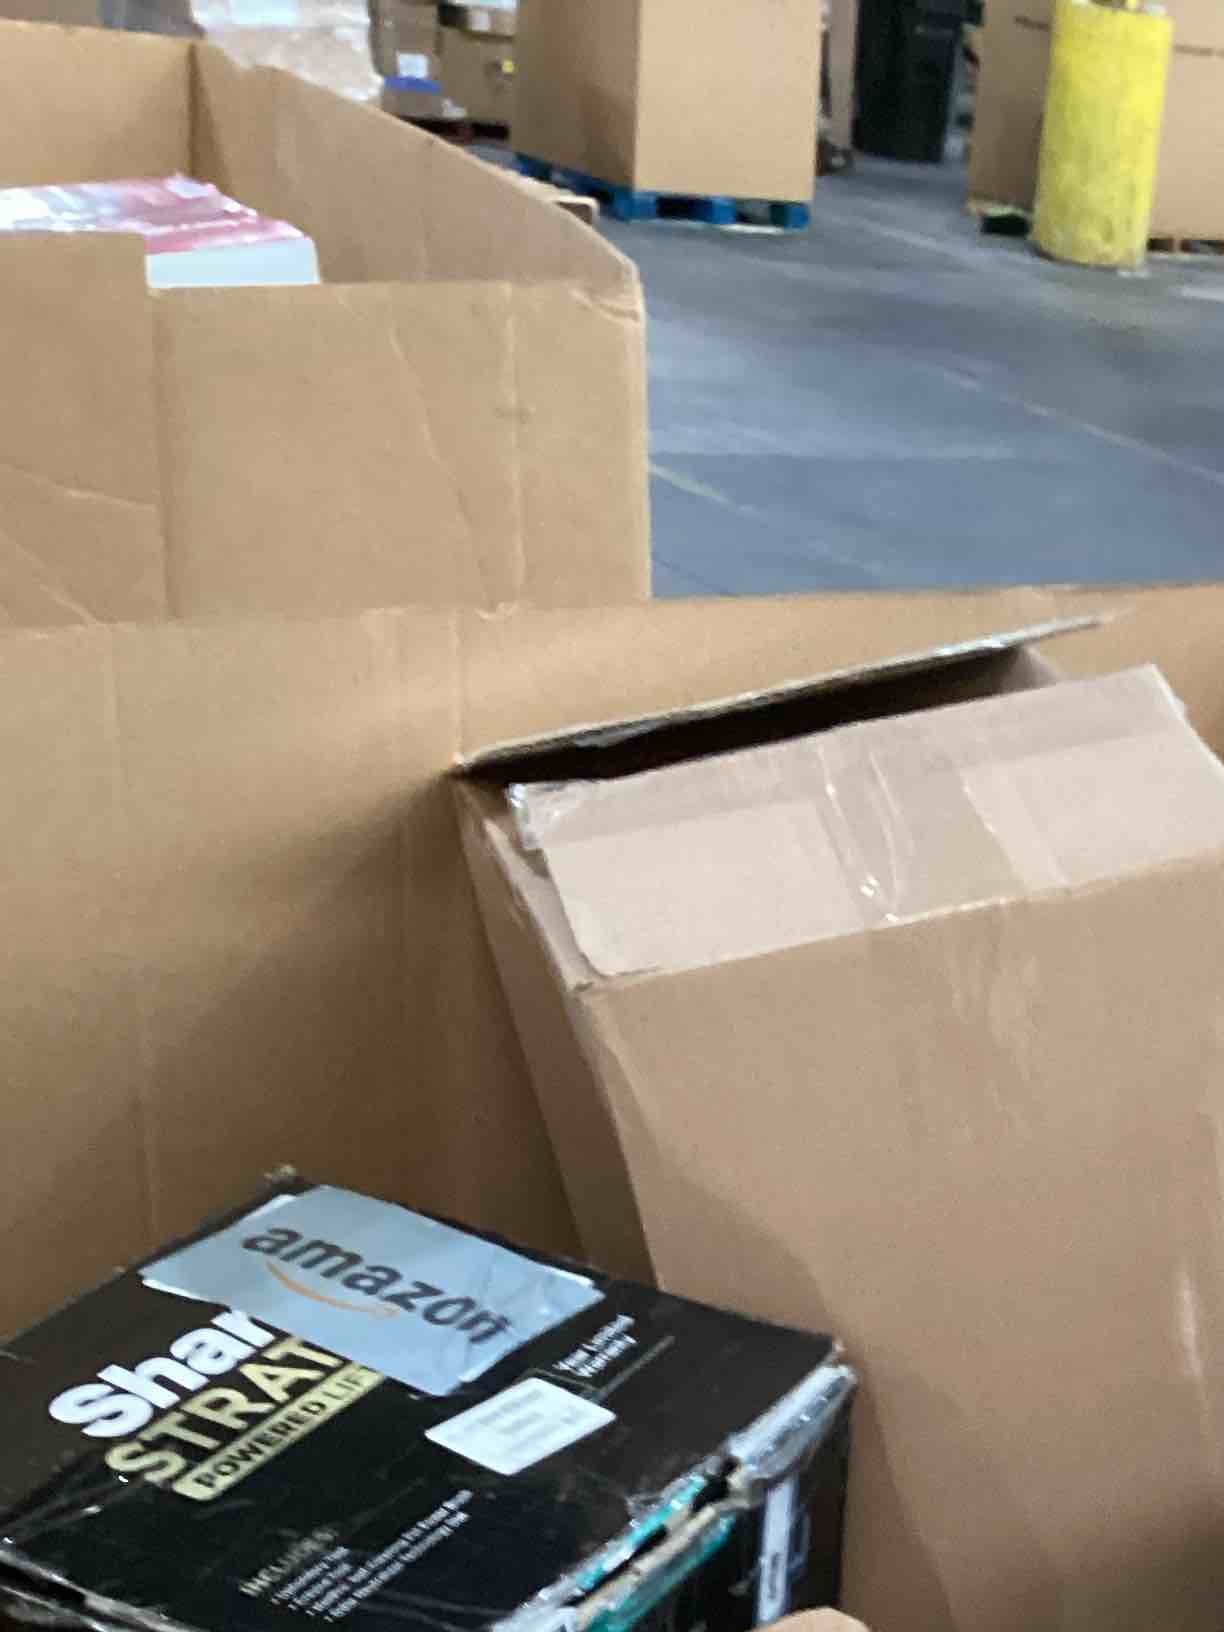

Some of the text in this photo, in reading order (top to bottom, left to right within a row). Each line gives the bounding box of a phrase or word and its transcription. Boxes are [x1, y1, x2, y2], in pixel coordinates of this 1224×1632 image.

[242, 1228, 512, 1344] amazon
[104, 1336, 345, 1485] STRAT
[195, 1365, 368, 1488] POWERED LIF
